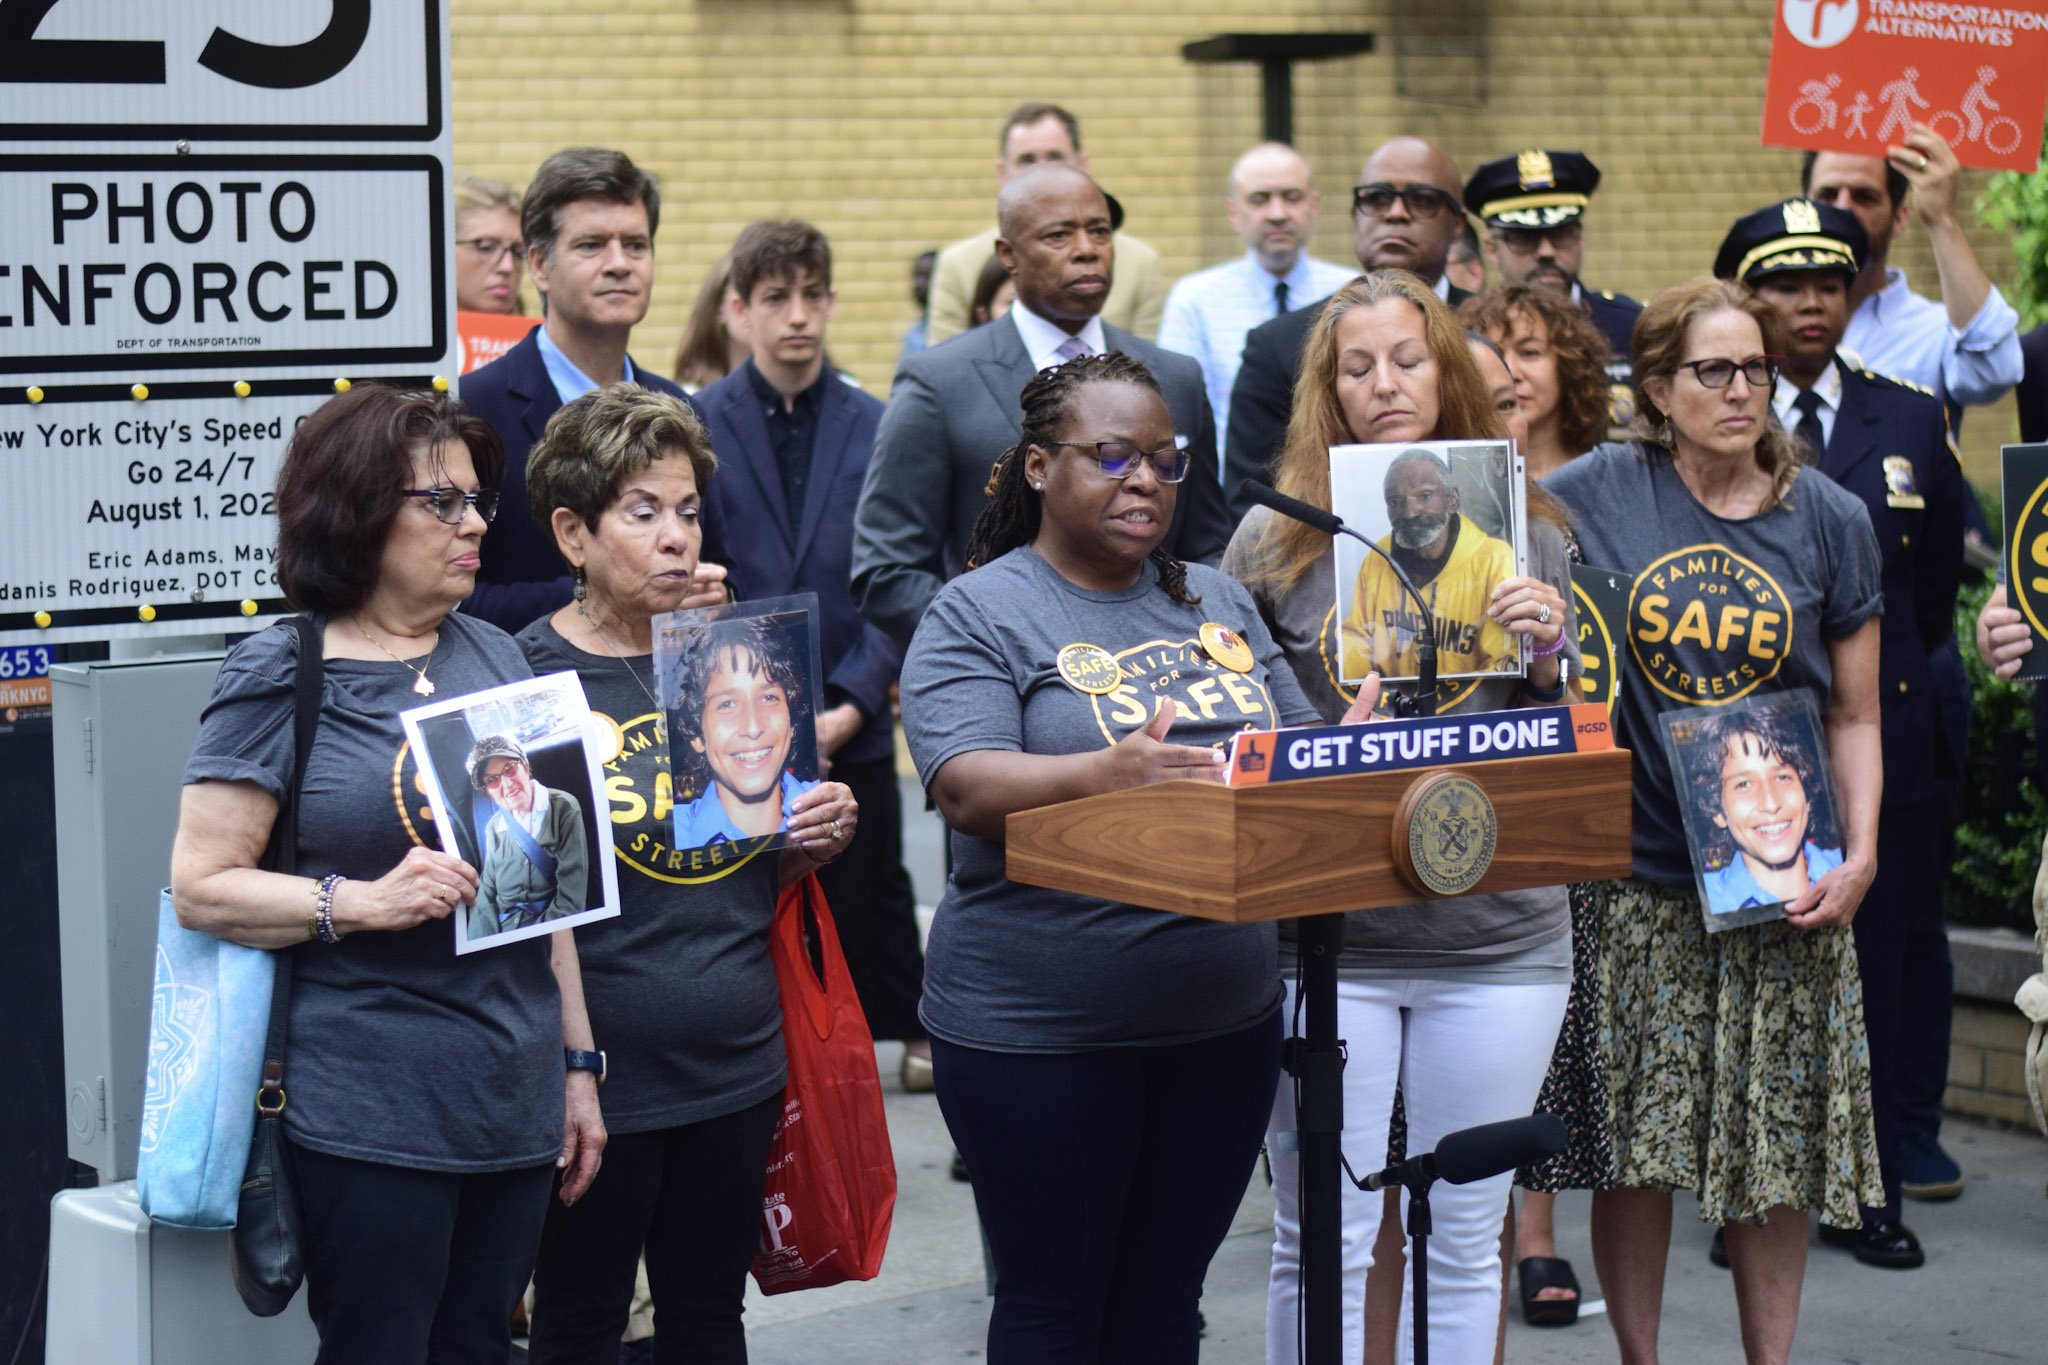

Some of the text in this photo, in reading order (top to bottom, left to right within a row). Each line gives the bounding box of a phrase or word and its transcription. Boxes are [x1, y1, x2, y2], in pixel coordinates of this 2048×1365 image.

[1863, 14, 2013, 47] ALTERNATIVES
[1867, 0, 2048, 32] TRANSPORTATION
[51, 181, 316, 245] PHOTO
[117, 337, 261, 349] DEPT OF TRANSPORTATION
[37, 422, 102, 448] York
[114, 419, 192, 450] City's
[203, 416, 282, 448] Speed
[128, 451, 256, 487] Go 24/7
[87, 491, 278, 530] August 1, 202
[89, 543, 277, 570] Eric Adams, May
[0, 581, 57, 601] danis
[69, 573, 185, 598] Rodriguez,
[197, 570, 242, 590] DOT
[1652, 555, 1773, 604] FAMILIES
[1699, 582, 1728, 595] FOR
[1638, 593, 1781, 660] SAFE
[1066, 658, 1115, 678] SAFE
[1150, 669, 1181, 691] FOR
[1650, 652, 1756, 695] STREETS
[1107, 672, 1264, 725] SAFE
[1288, 736, 1352, 770] GET
[1360, 726, 1460, 764] STUFF
[1468, 717, 1560, 754] DONE
[1577, 721, 1607, 734] #GSD
[631, 832, 757, 871] STREET
[764, 1192, 785, 1205] tate
